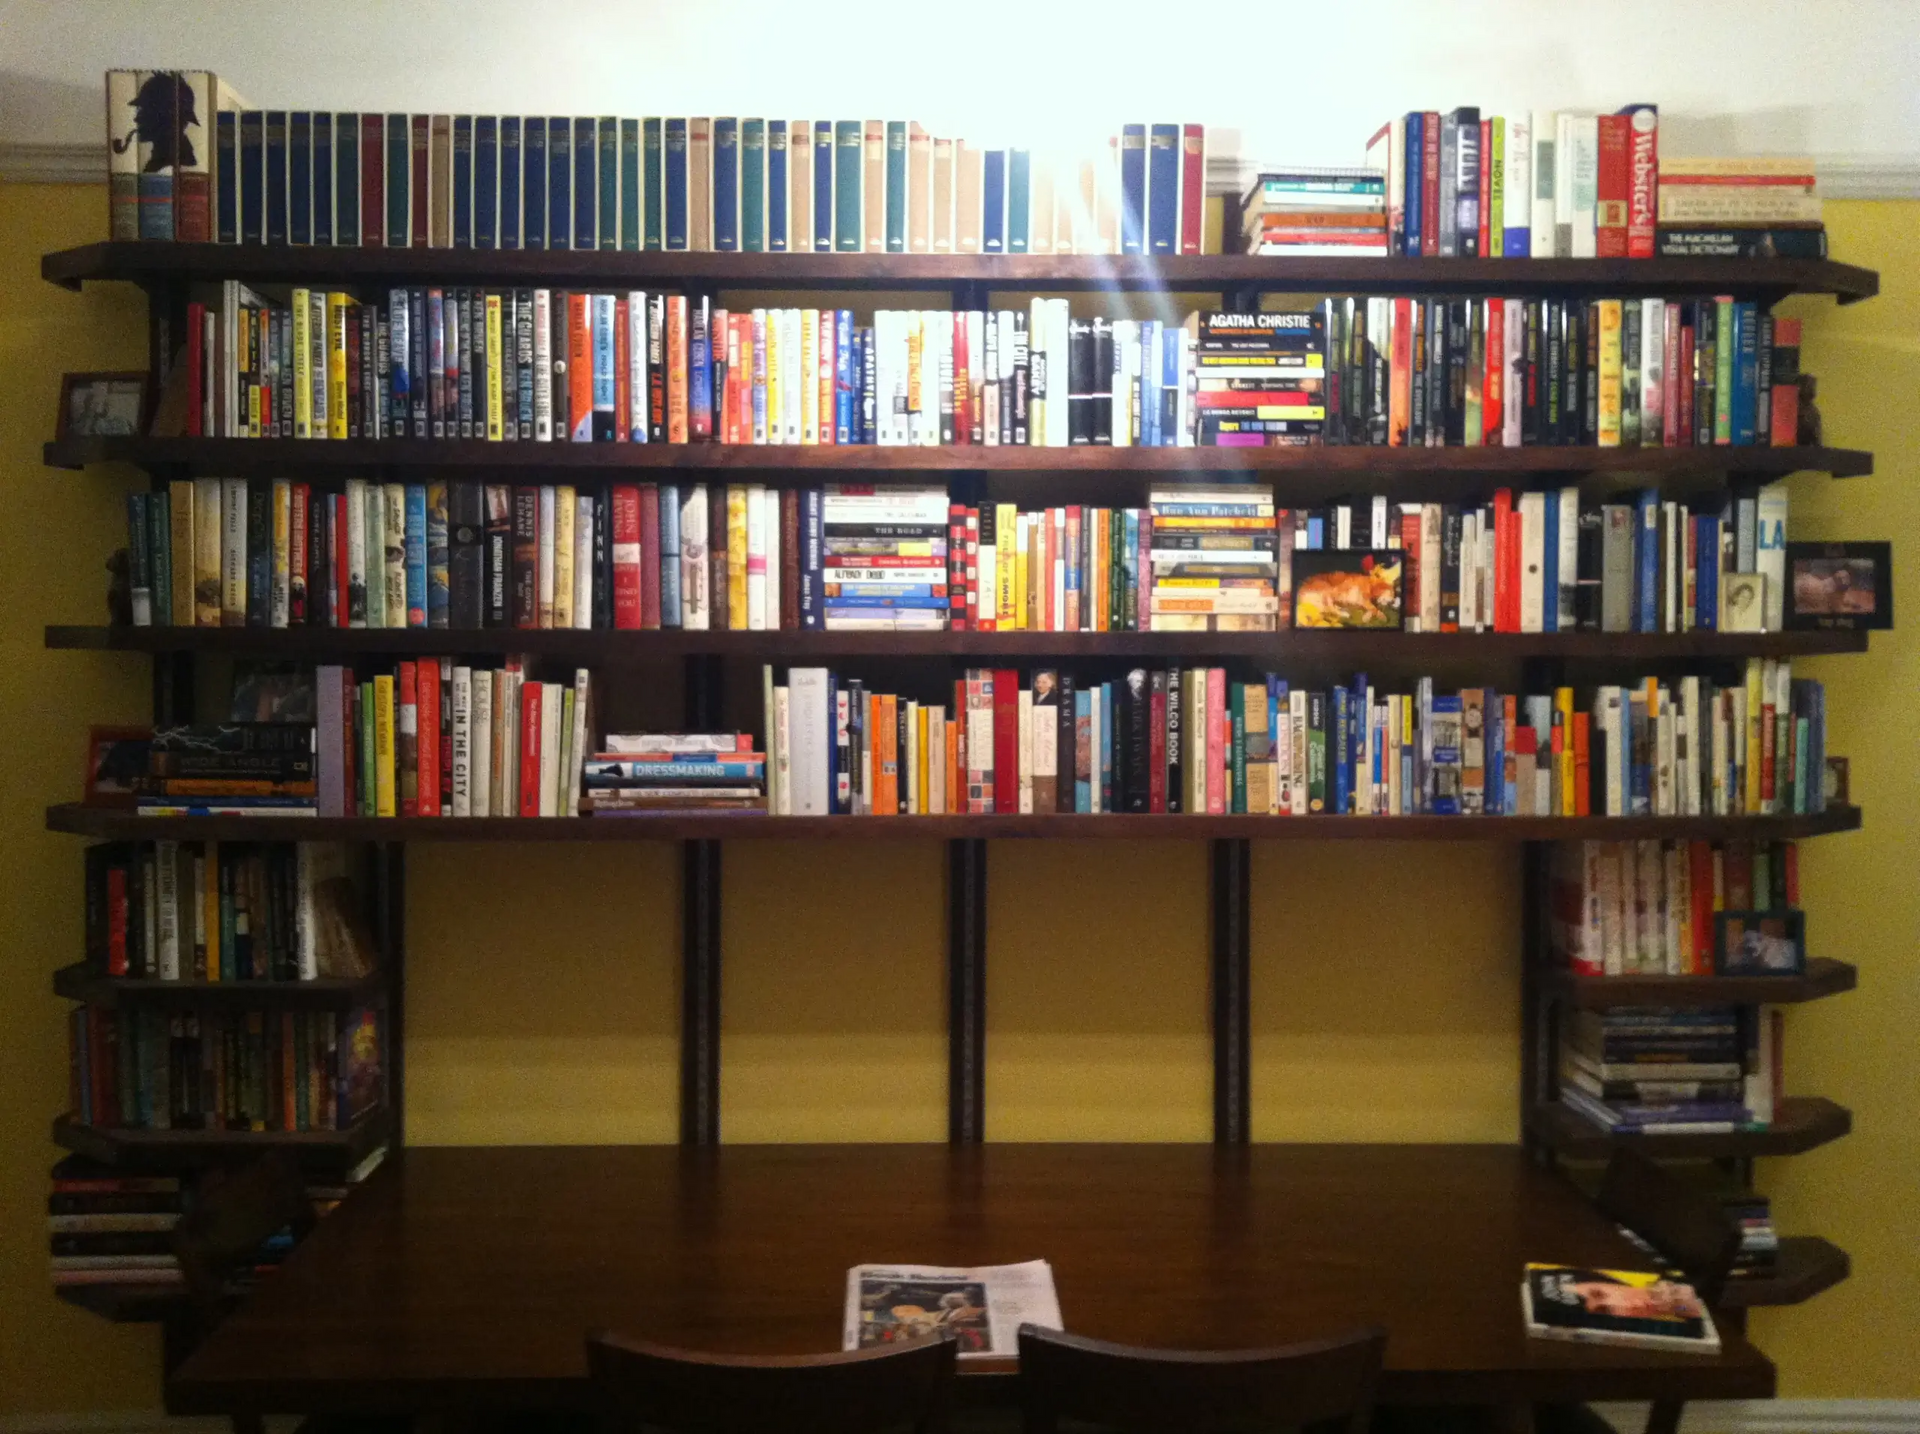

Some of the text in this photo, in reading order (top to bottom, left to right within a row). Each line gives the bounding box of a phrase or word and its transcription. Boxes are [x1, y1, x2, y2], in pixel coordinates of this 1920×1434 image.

[1634, 134, 1653, 226] Webster's
[518, 301, 532, 364] THE GUARDS
[1209, 314, 1311, 329] AGATHA CHRISTIE
[864, 347, 875, 392] APATHY
[516, 495, 526, 538] LEHANE
[524, 495, 535, 538] DENNIS
[613, 494, 625, 539] IRVING
[624, 499, 638, 534] JOHN
[492, 535, 504, 607] JONATHAN FRANZEN
[802, 574, 812, 610] James Frey
[1061, 677, 1072, 728] DRAMA
[1169, 691, 1180, 729] WILCO
[228, 758, 281, 768] ANGLE
[454, 709, 468, 797] IN THE CITY
[1169, 732, 1180, 765] BOOK
[635, 764, 726, 777] DRESSMAKING
